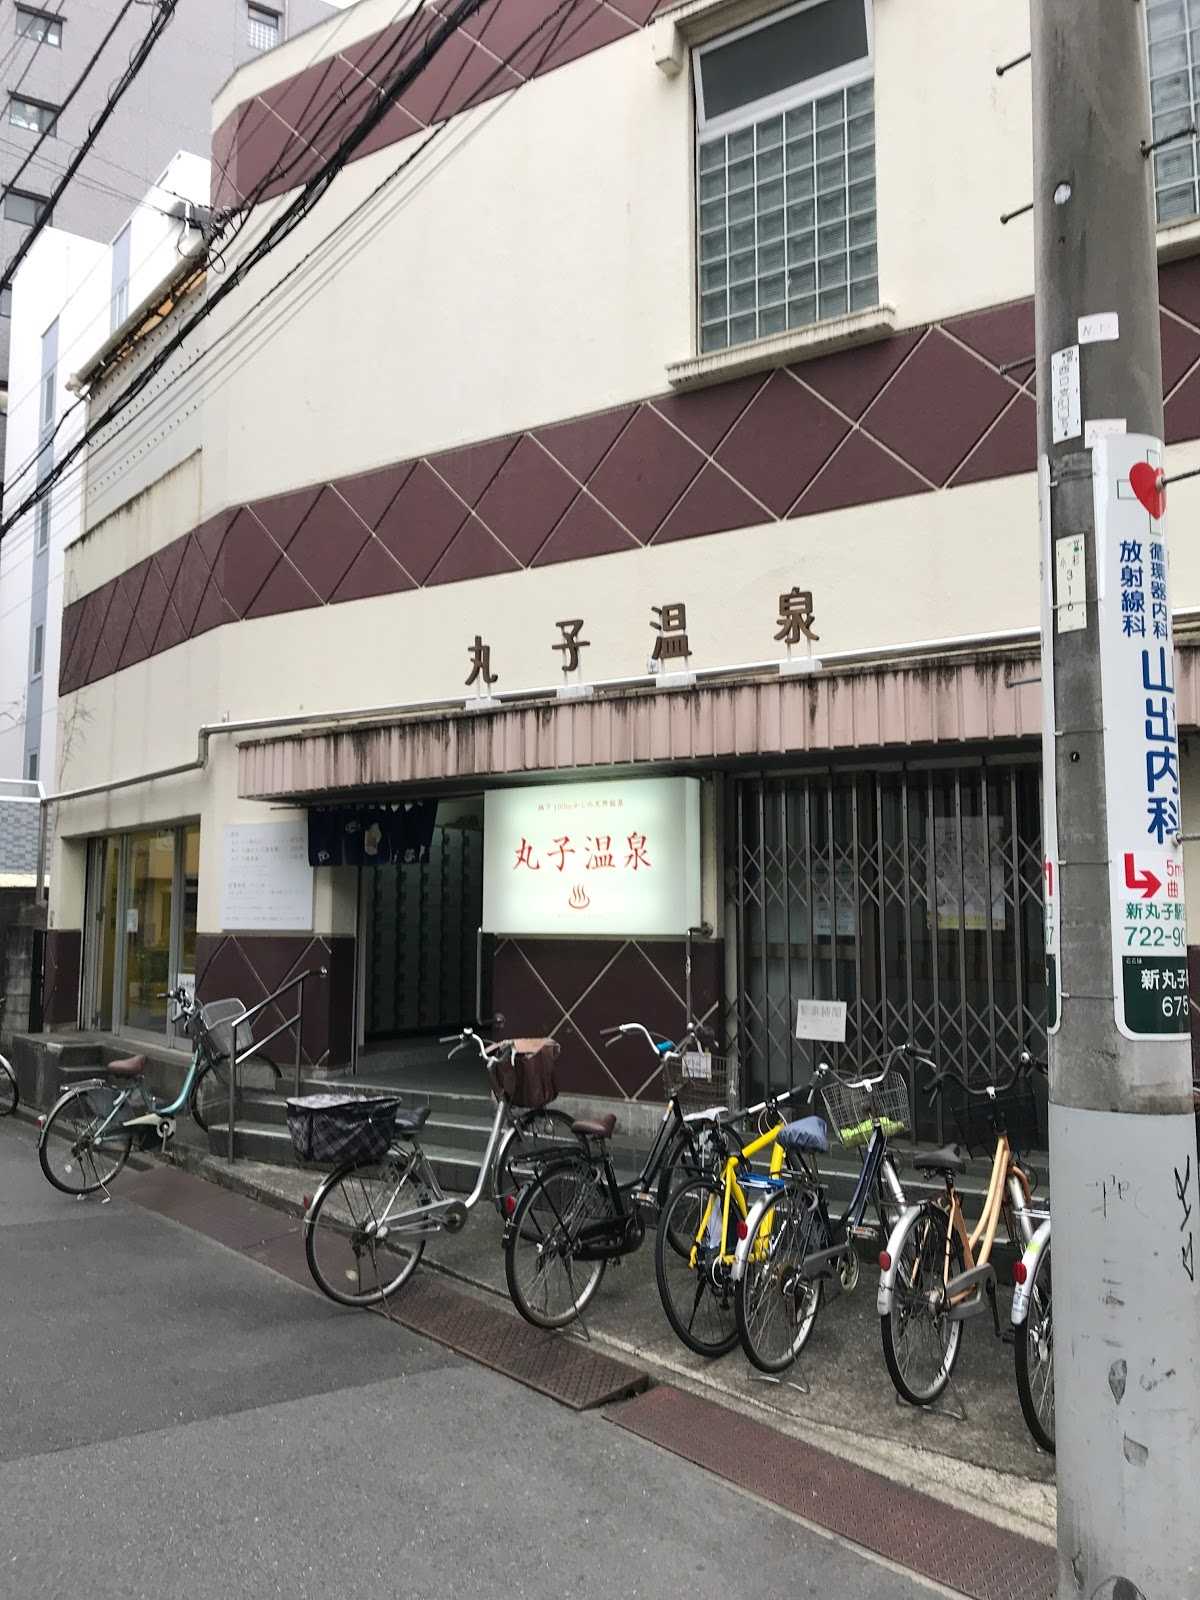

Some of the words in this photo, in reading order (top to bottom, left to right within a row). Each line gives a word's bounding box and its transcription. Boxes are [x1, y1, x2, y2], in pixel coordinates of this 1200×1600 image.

[464, 586, 820, 687] 丸子温泉
[1120, 539, 1146, 638] 放射線科
[1141, 646, 1180, 844] 山出内科
[513, 832, 652, 872] 丸子温泉
[1140, 969, 1189, 991] 新丸子
